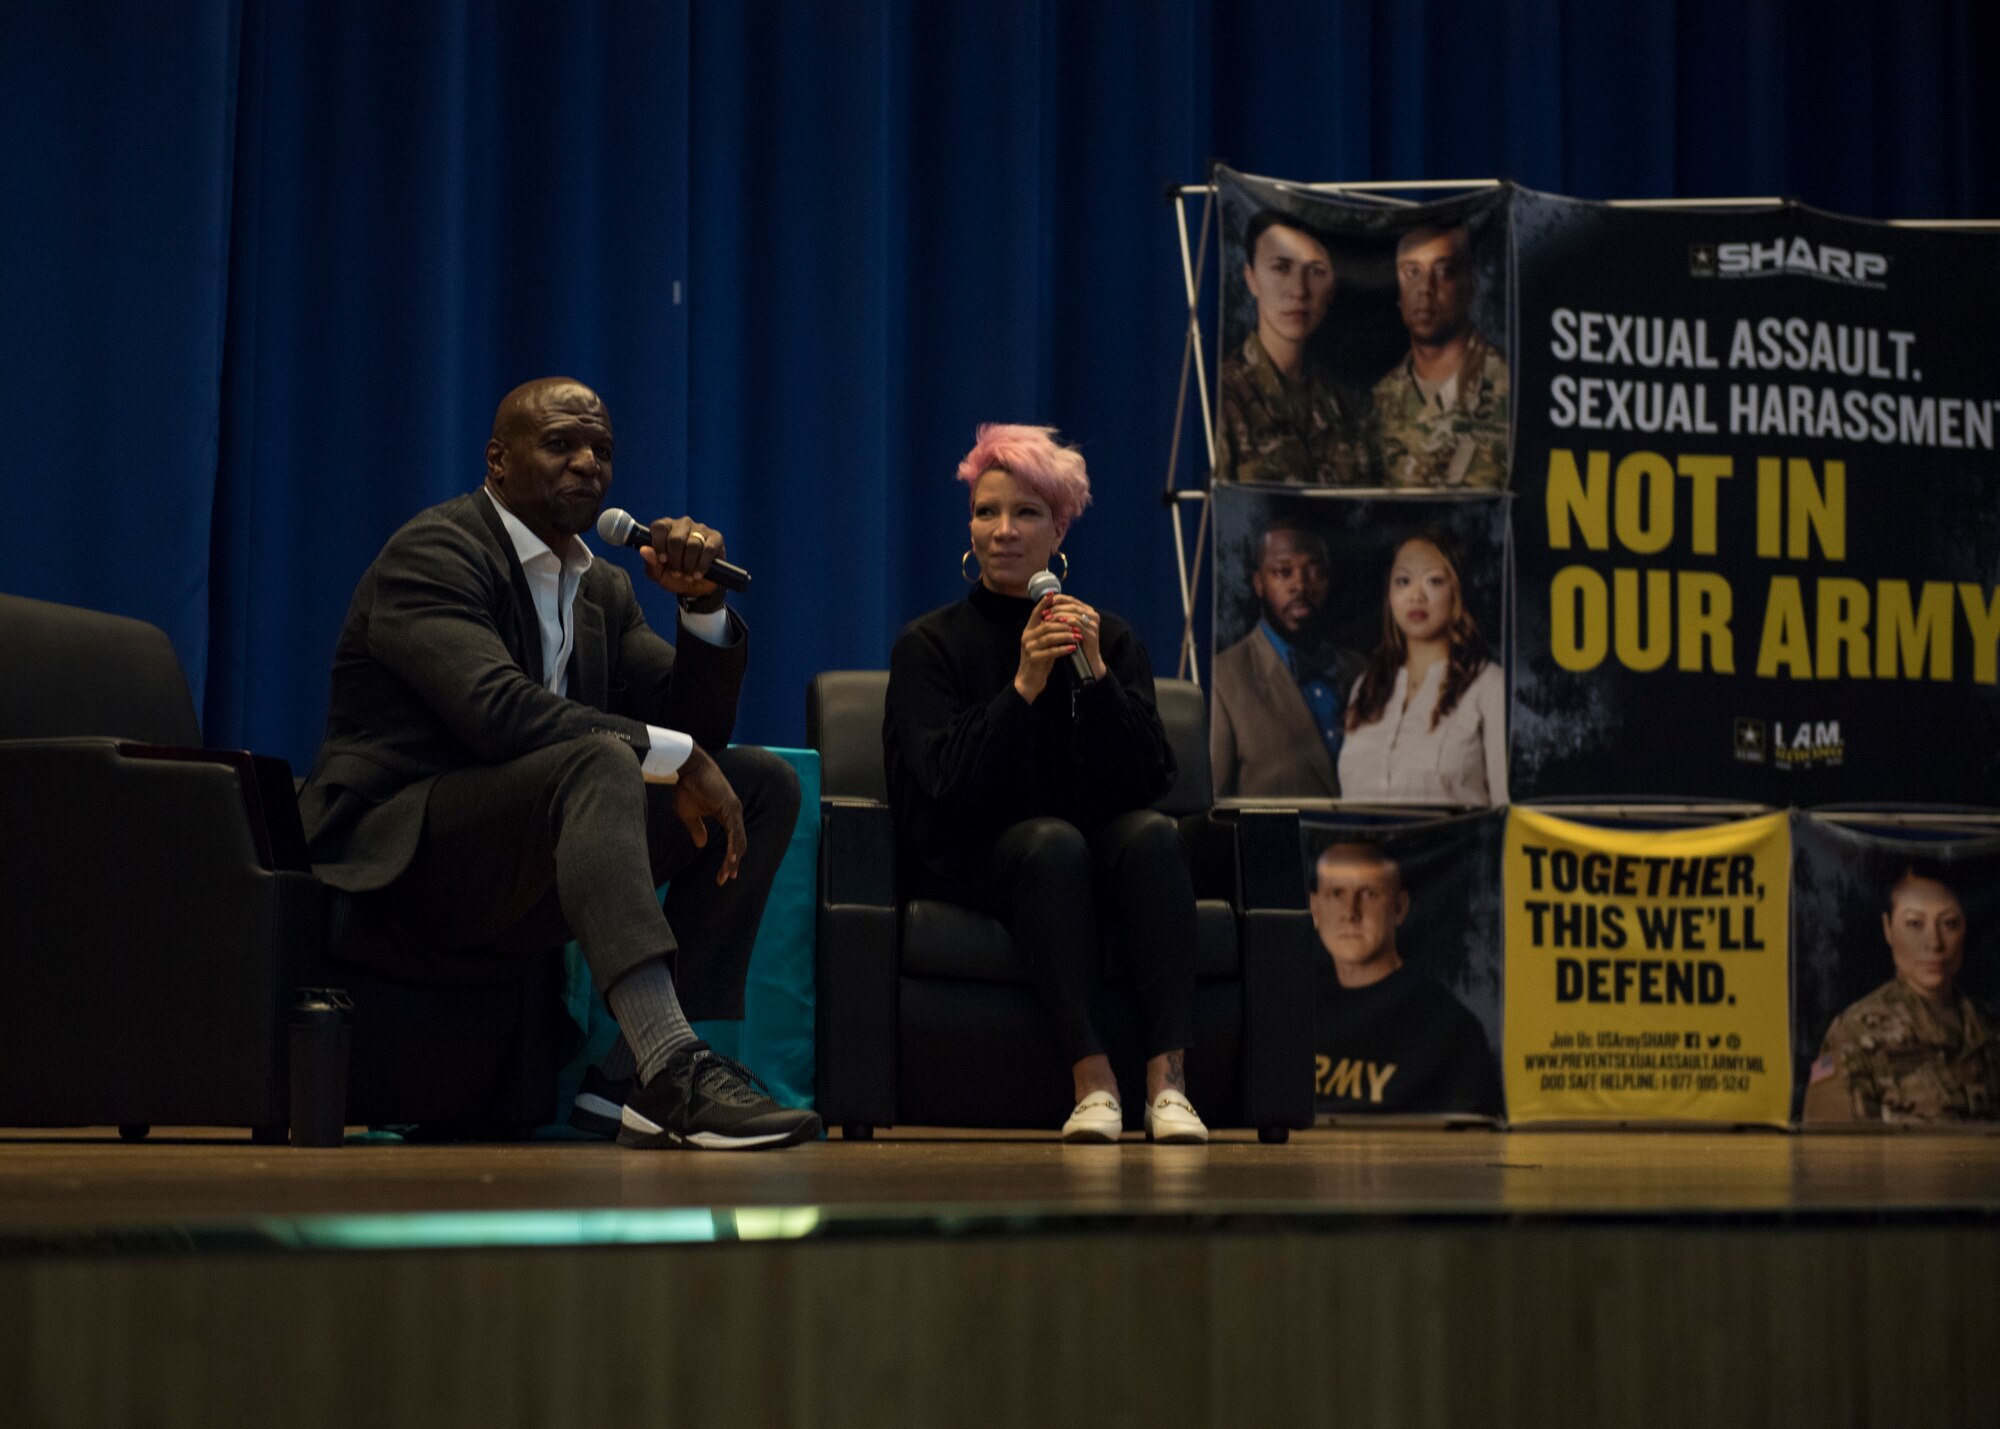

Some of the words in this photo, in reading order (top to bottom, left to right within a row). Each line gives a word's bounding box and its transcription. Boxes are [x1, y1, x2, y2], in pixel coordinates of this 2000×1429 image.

[1717, 237, 1888, 280] SHARP
[1551, 308, 1718, 369] SEXUAL
[1728, 317, 1922, 382] ASSAULT.
[1550, 375, 1718, 434] SEXUAL
[1546, 448, 1734, 555] NOT
[1757, 455, 1847, 562] IN
[1550, 565, 1736, 675] OUR
[1755, 575, 2000, 686] ARMY
[1522, 845, 1765, 901] TOGETHER,
[1525, 900, 1628, 949] THIS
[1636, 905, 1765, 951] WE'LL
[1555, 957, 1737, 1006] DEFEND.
[1550, 1031, 1575, 1049] Join
[1314, 1053, 1398, 1105] RMY
[1568, 1074, 1597, 1091] SAFE
